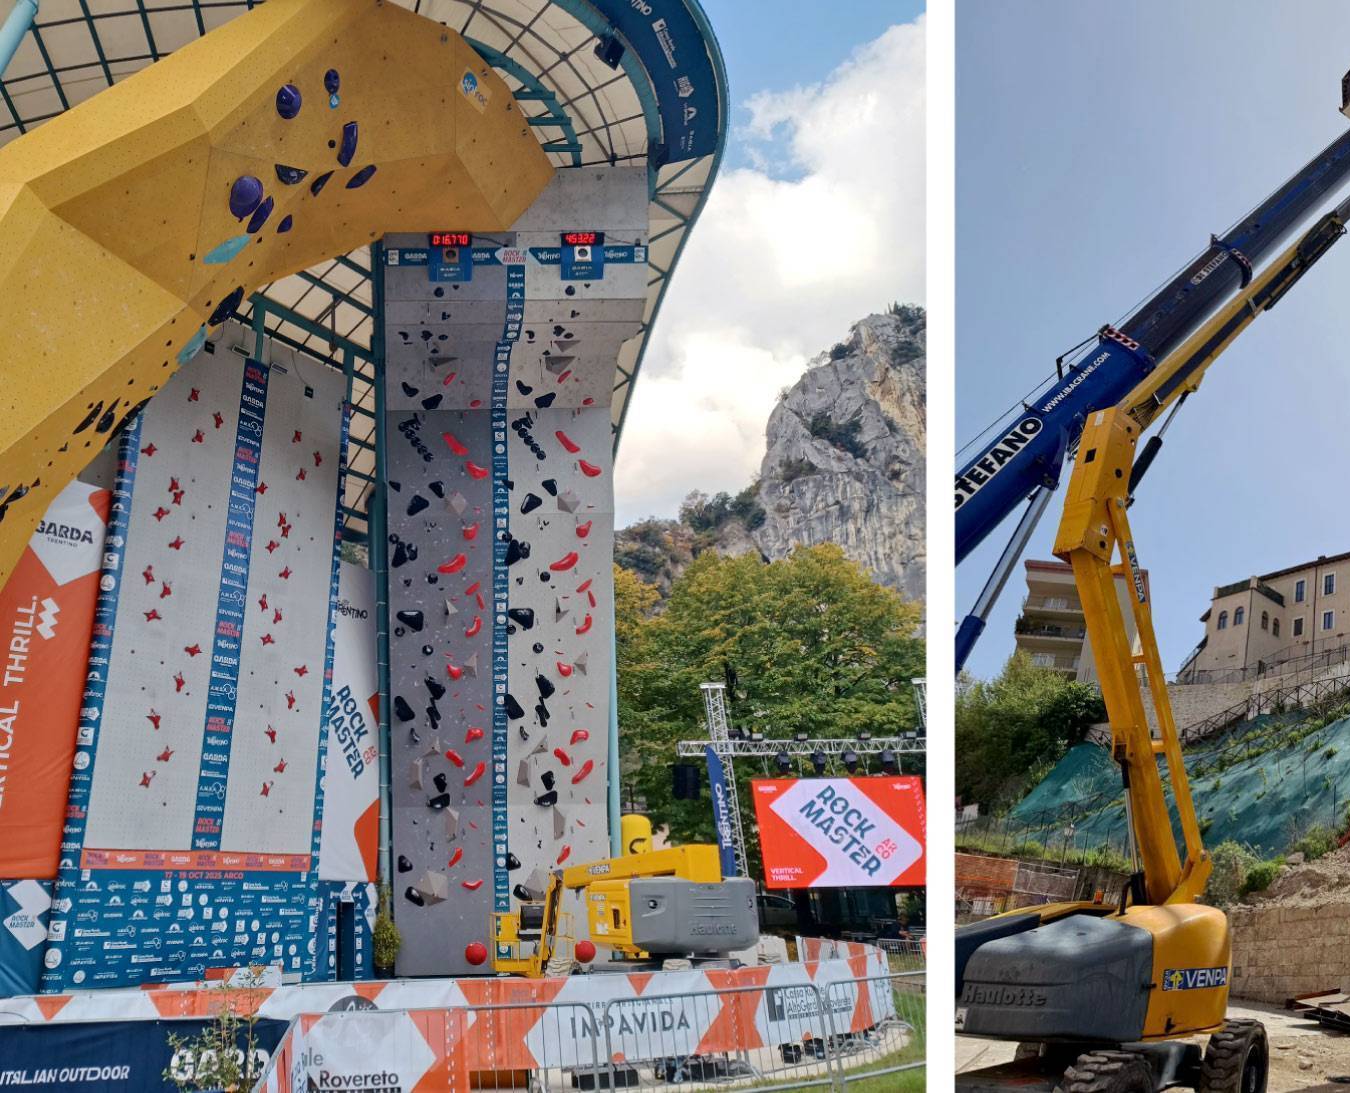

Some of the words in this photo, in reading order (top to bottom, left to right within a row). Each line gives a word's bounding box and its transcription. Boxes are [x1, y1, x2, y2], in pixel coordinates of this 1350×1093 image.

[1041, 351, 1111, 414] WWW.IBACRANE.COM
[1129, 556, 1146, 603] VENPA
[3, 595, 38, 687] THRILL.
[336, 685, 369, 744] ROCK
[715, 783, 733, 849] TRENTINO
[816, 785, 876, 840] ROCK
[800, 800, 882, 877] MASTER
[223, 872, 244, 880] ARCO
[770, 867, 803, 875] VERTICAL
[964, 983, 1048, 1006] Haulotte
[1186, 968, 1227, 988] VENPA
[59, 1065, 131, 1083] OUTDOOR
[319, 1070, 399, 1088] Rovereto
